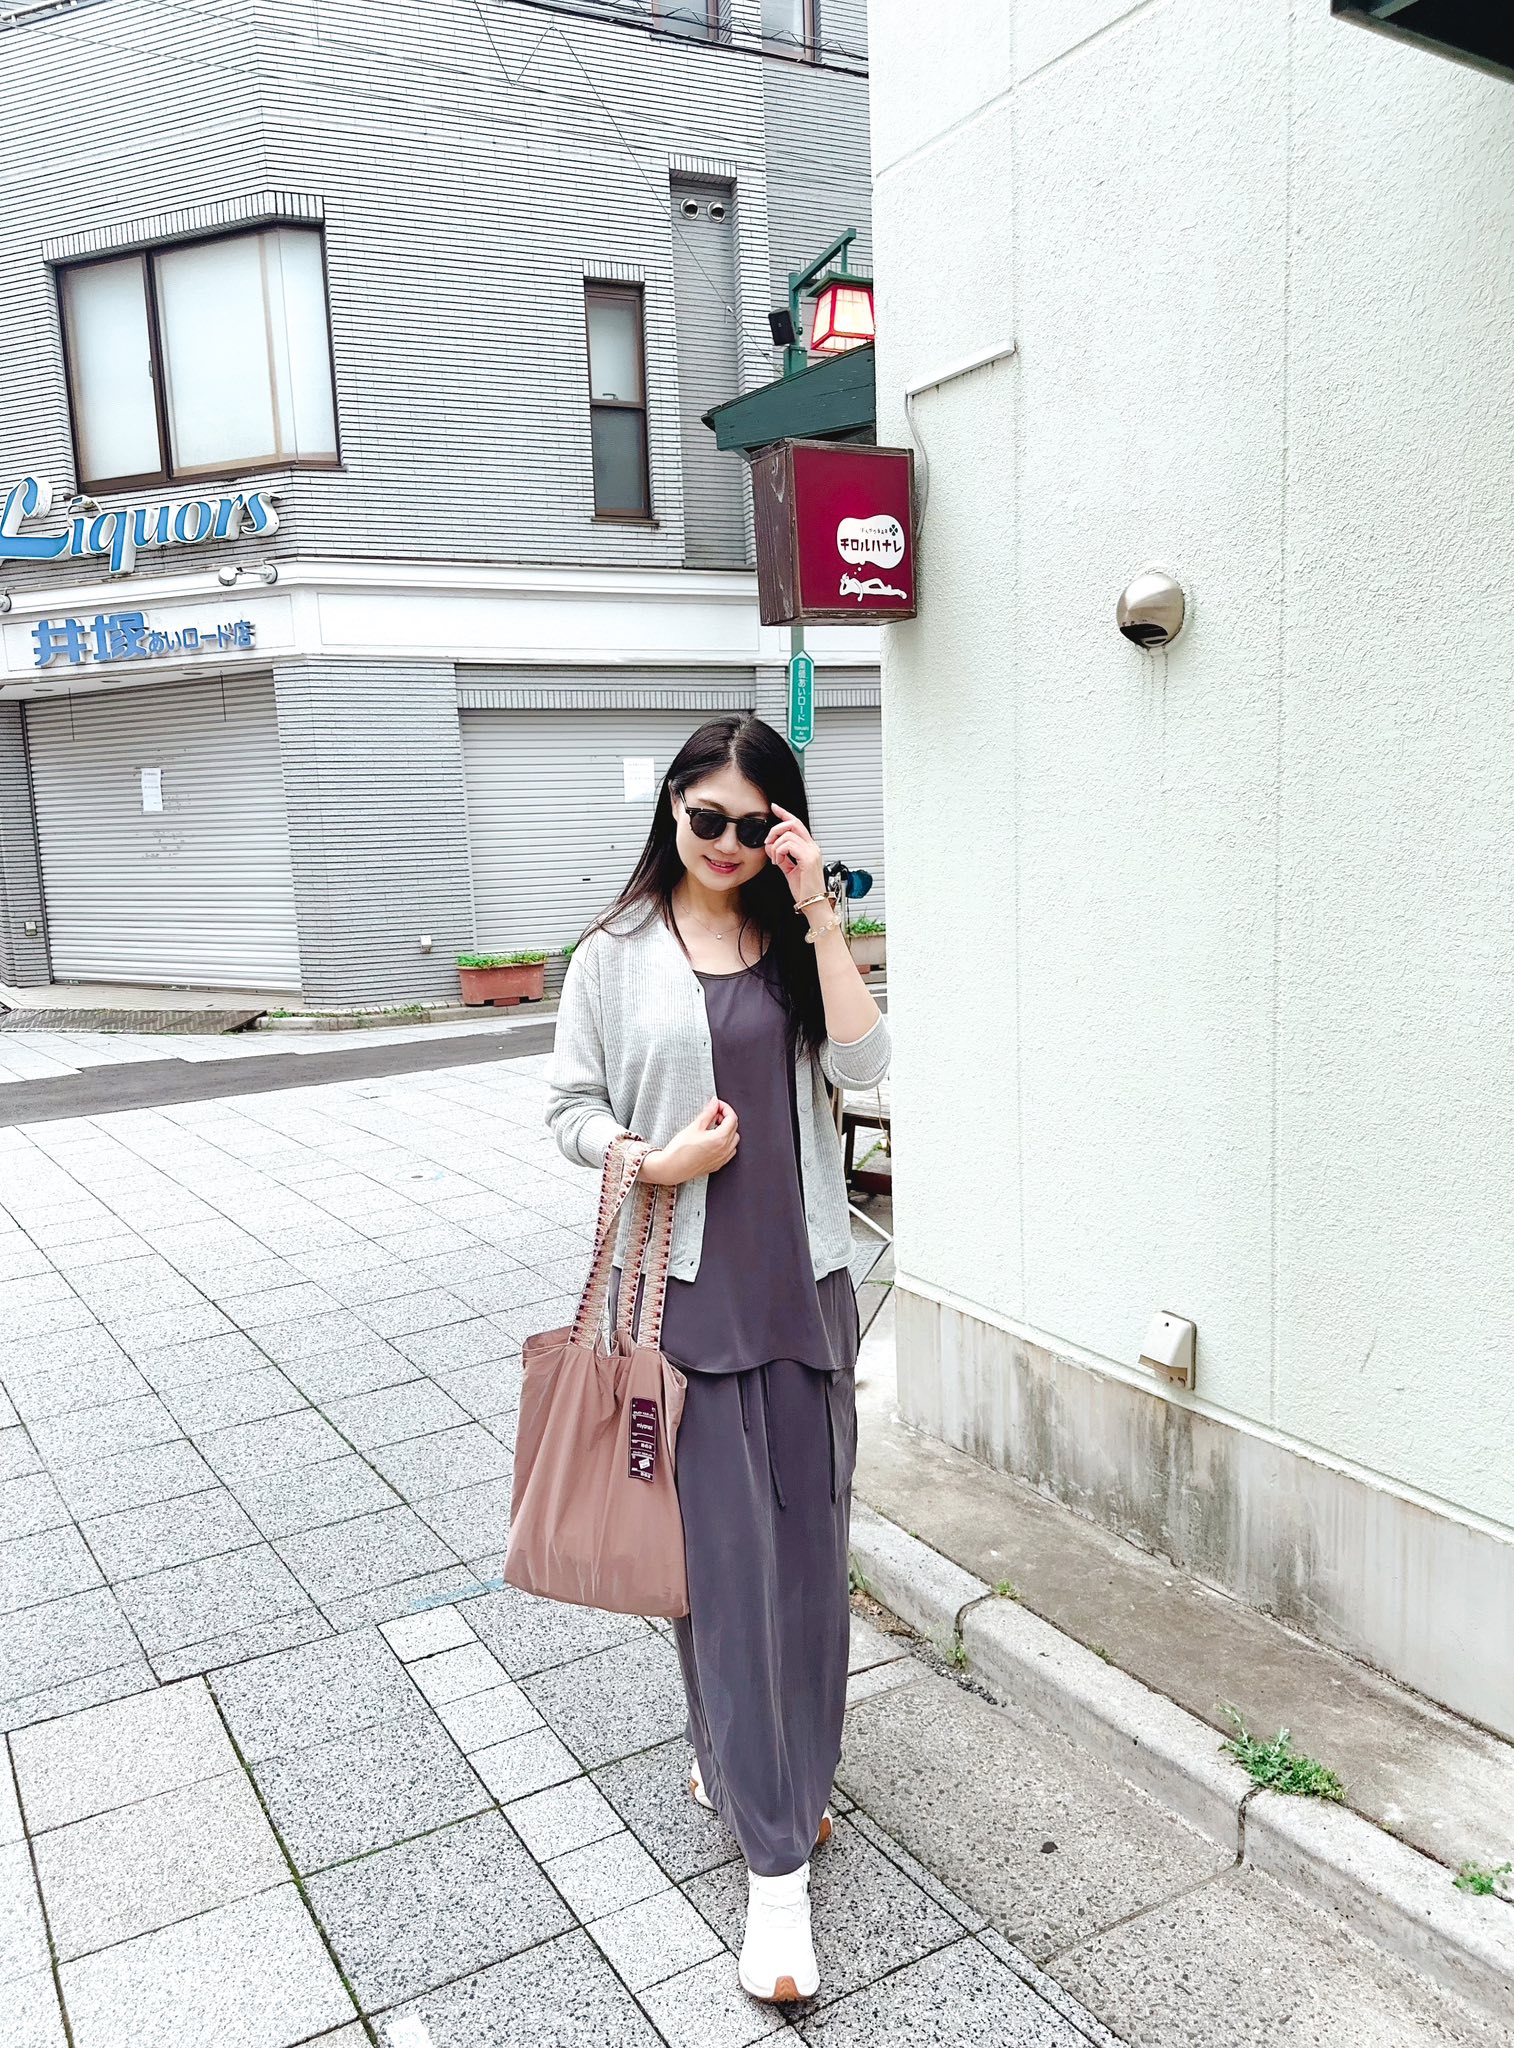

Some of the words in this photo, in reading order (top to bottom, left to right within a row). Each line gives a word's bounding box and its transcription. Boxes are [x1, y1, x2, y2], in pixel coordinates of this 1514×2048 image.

[0, 476, 280, 574] Liquors
[840, 538, 902, 553] チロルハナレ
